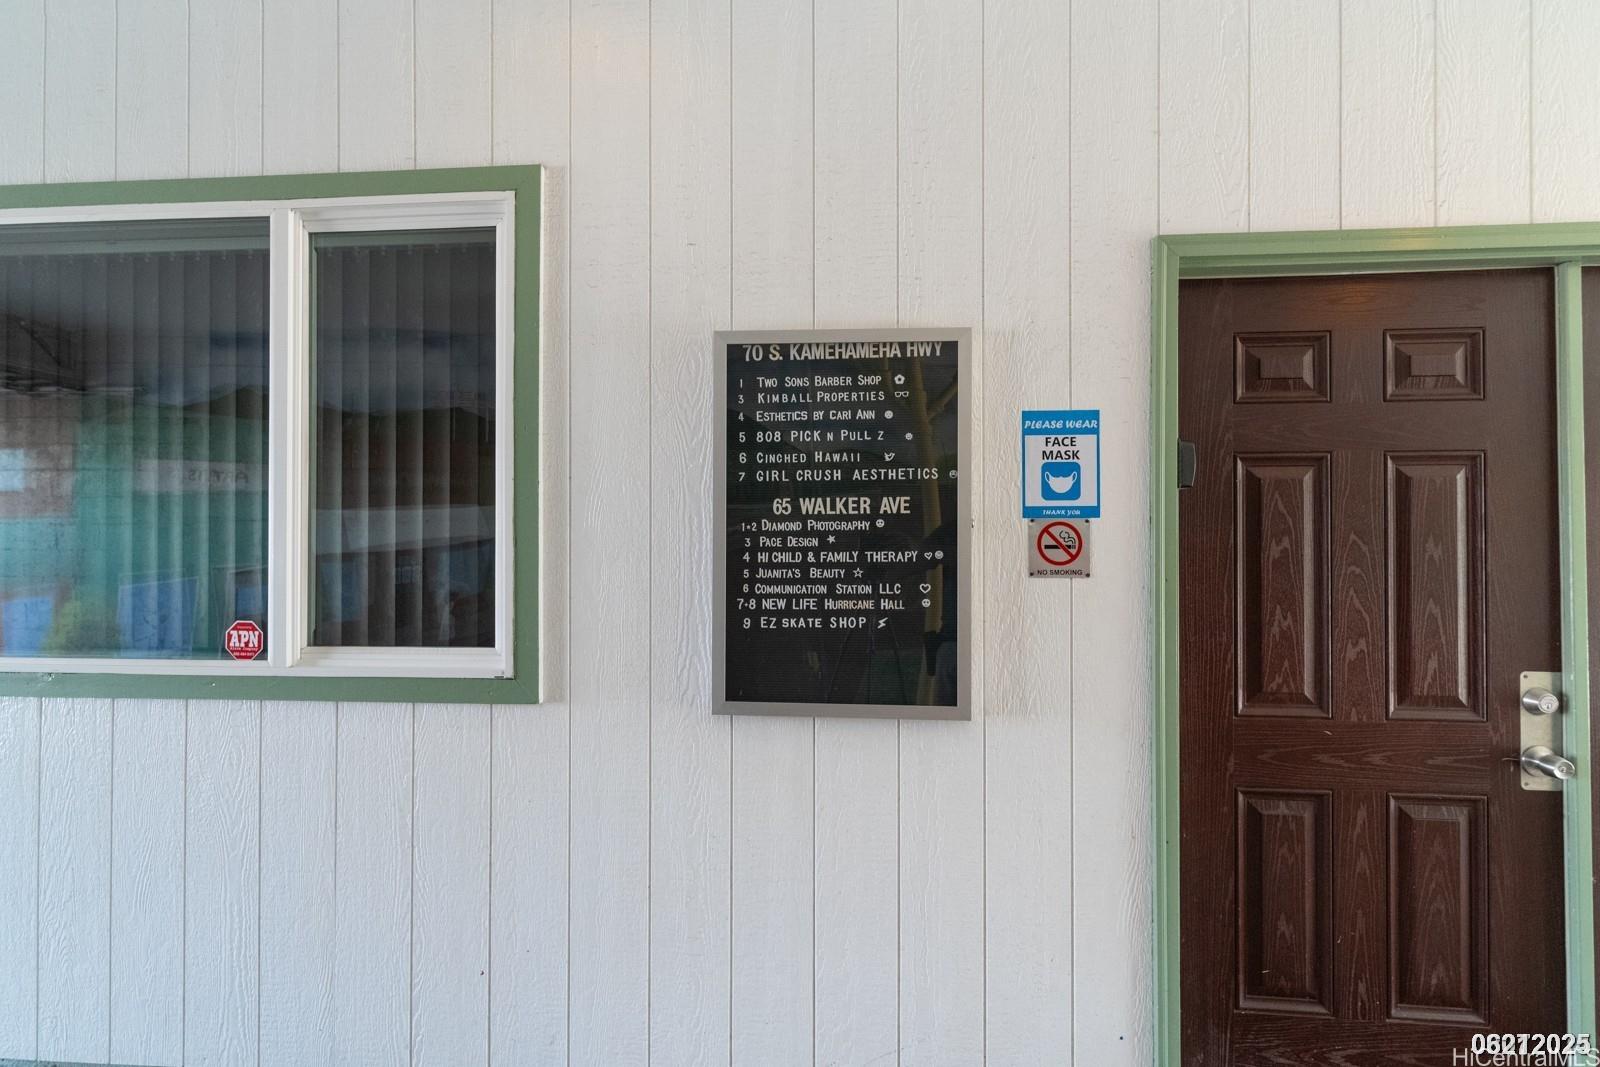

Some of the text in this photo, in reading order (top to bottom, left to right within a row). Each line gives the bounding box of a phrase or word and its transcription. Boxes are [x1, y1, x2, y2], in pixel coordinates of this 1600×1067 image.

[742, 344, 763, 361] 70
[790, 342, 901, 360] KAMEHAMEHA
[907, 341, 942, 357] HWY
[756, 376, 778, 388] TWO
[784, 376, 810, 387] SONS
[815, 375, 852, 387] BARBER
[858, 374, 882, 386] SHOP
[738, 391, 885, 404] 3 KIMBALL PROPERTIES
[738, 409, 875, 422] 4 ESTHETICS BY CARI ANN
[1024, 419, 1098, 429] PLEASE WEAR
[739, 431, 746, 442] 5
[756, 430, 781, 442] 808
[790, 429, 821, 442] PICK
[841, 429, 872, 441] PULL
[1045, 437, 1077, 447] FACE
[739, 451, 860, 463] 6 CINCHED HAWAII
[1042, 450, 1080, 460] MASK
[738, 467, 939, 482] 7 GIRL CRUSH AESTHETICS
[773, 496, 911, 515] 65 WALKER AVE
[761, 519, 802, 531] DIAMOND
[807, 519, 871, 531] PHOTOGRAPHY
[744, 536, 819, 547] 3 PACE DESIGN
[743, 550, 918, 563] 4 HI CHILD & FAMILY THERAPY
[743, 567, 845, 578] 5 JUANITA'S BEAUTY
[743, 583, 902, 595] 6 COMMUNICATION STATION LLC
[762, 598, 787, 610] NEW
[792, 598, 818, 610] LIFE
[824, 598, 875, 610] HURRICANE
[880, 598, 905, 610] HALL
[760, 616, 777, 629] EZ
[781, 618, 822, 629] SKATE
[829, 616, 867, 629] SHOP
[230, 630, 259, 647] APN
